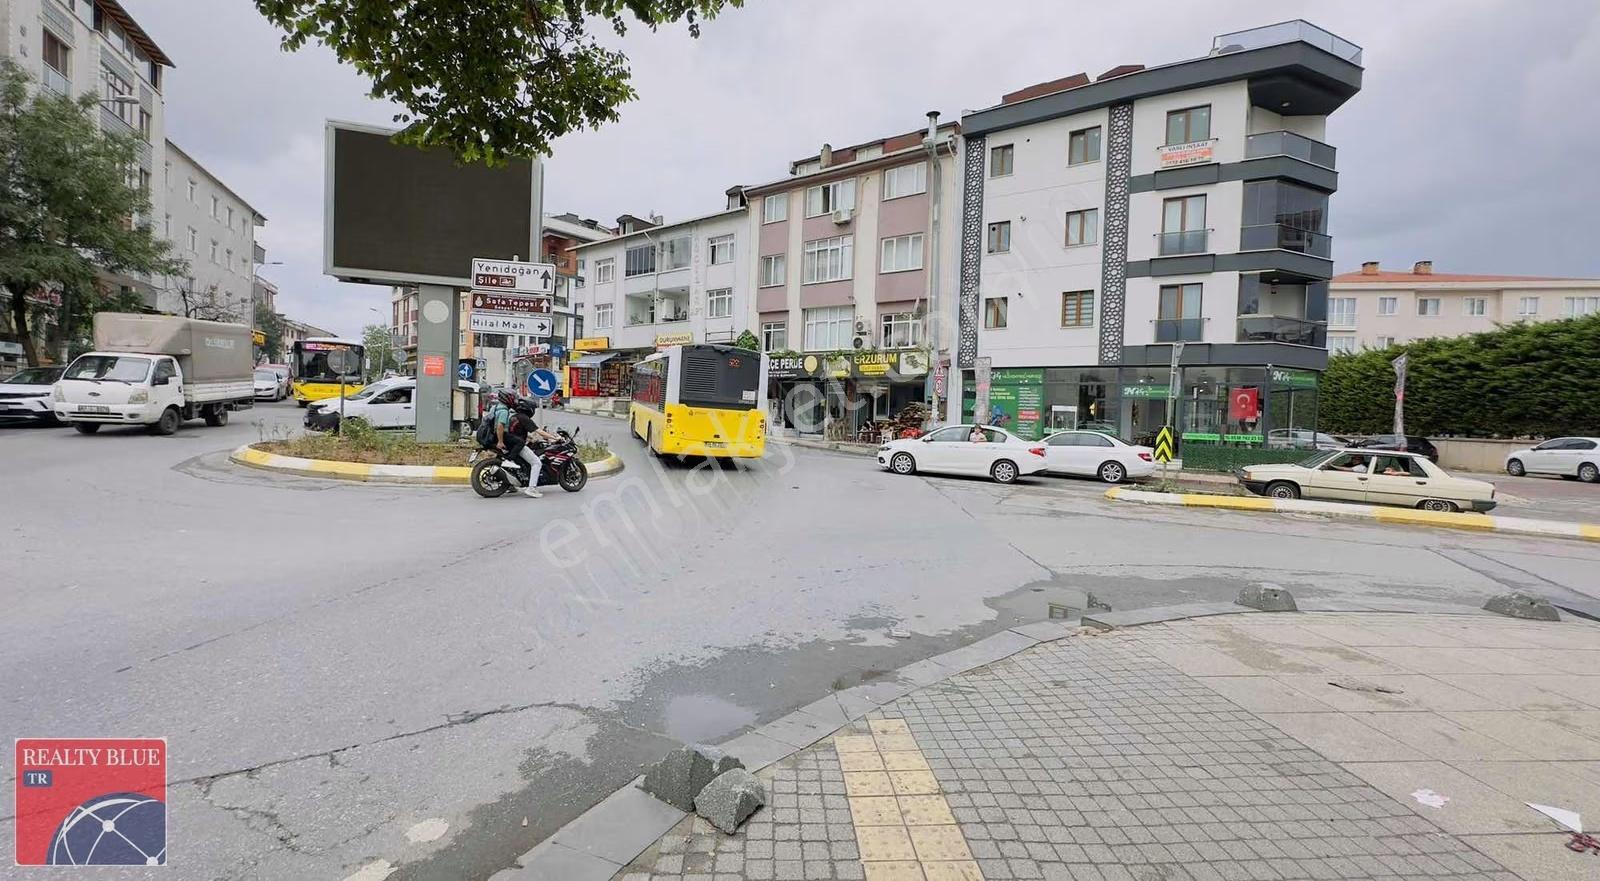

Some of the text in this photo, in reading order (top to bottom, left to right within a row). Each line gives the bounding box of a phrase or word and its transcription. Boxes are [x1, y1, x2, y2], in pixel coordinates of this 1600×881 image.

[478, 264, 539, 276] Yenidoğan
[472, 319, 525, 329] Hilal Mah
[853, 353, 897, 364] ERZURUM
